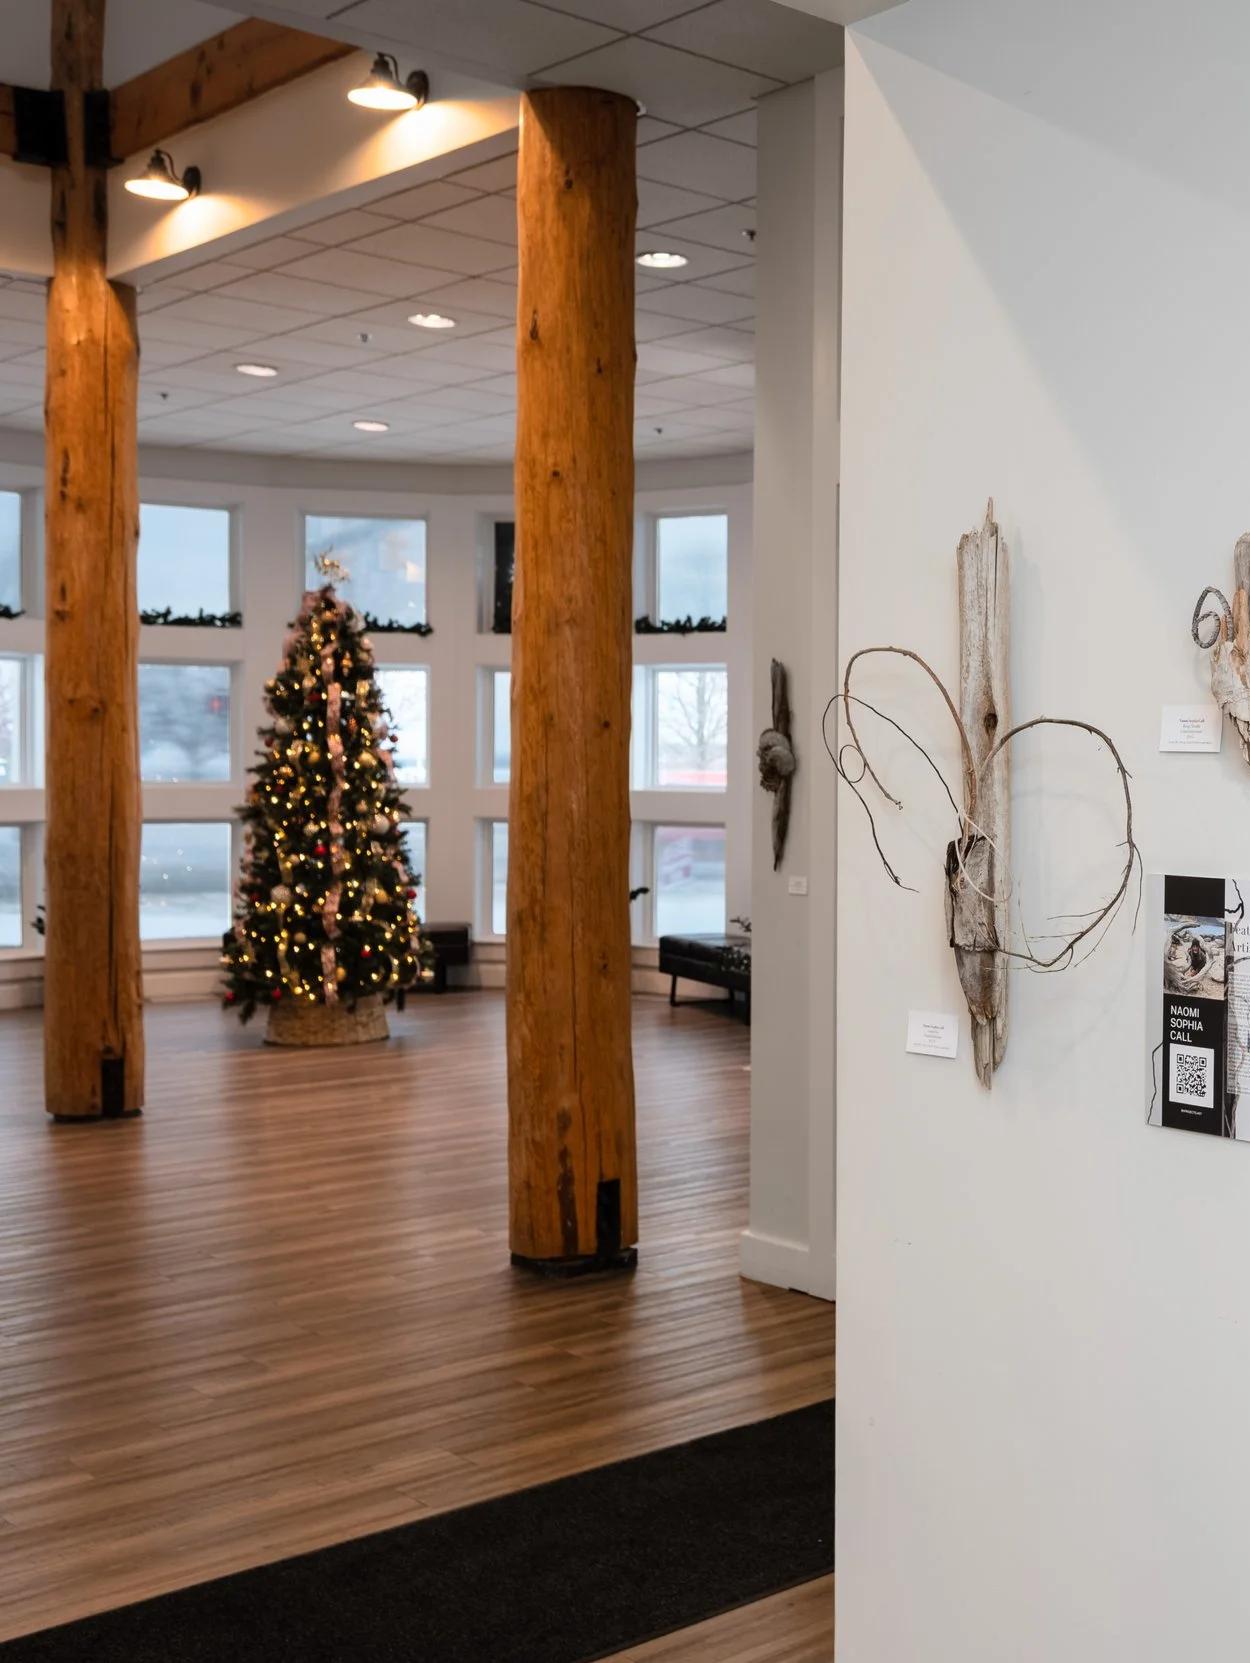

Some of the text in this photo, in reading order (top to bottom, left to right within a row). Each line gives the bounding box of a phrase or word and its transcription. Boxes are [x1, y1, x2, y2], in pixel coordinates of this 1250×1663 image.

[1170, 1004, 1200, 1018] NAOMI
[1170, 1017, 1204, 1031] SOPHIA
[1170, 1030, 1193, 1043] CALL
